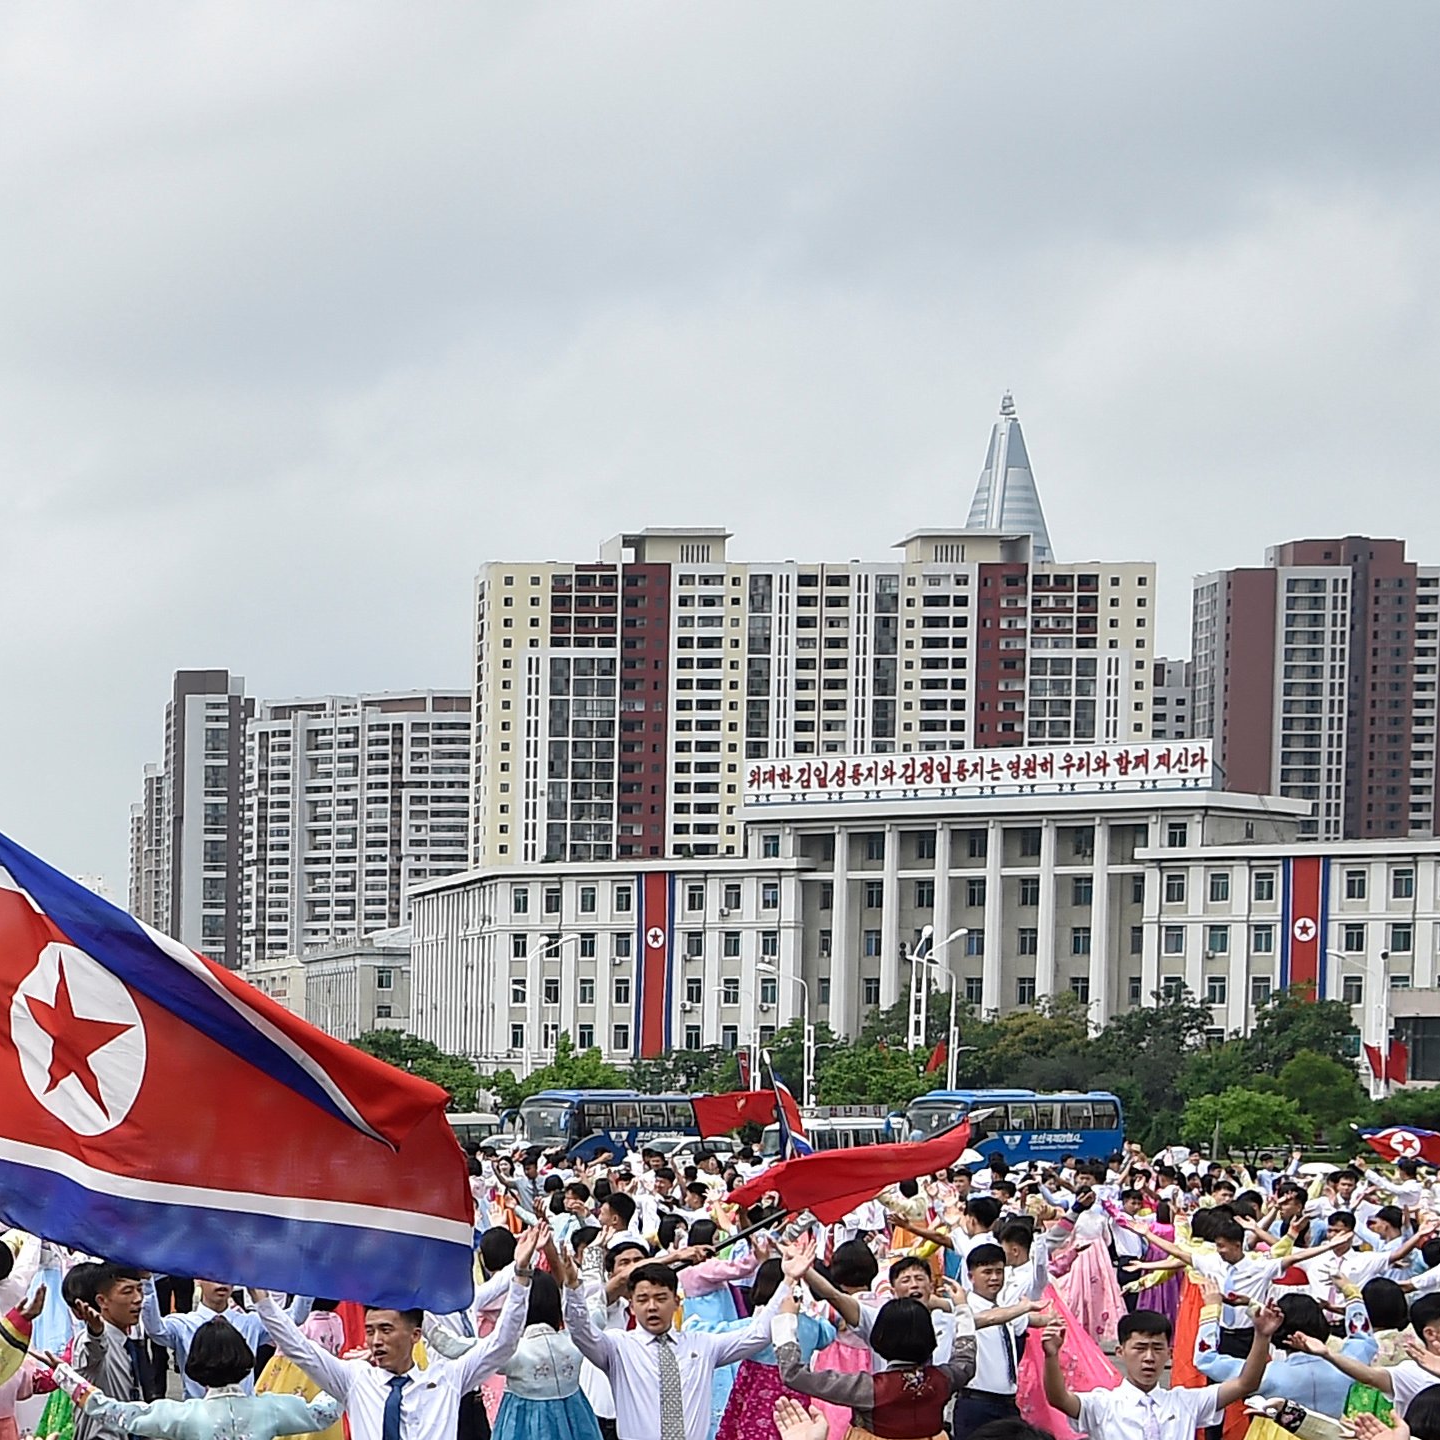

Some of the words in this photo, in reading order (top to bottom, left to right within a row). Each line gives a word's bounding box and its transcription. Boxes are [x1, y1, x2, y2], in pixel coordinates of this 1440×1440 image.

[747, 765, 793, 790] 위대한
[795, 760, 898, 789] 김일성동지와
[899, 755, 1004, 784] 김정일동지는
[1006, 752, 1055, 781] 영원히
[1058, 750, 1110, 777] 우리와
[1113, 748, 1149, 776] 함께
